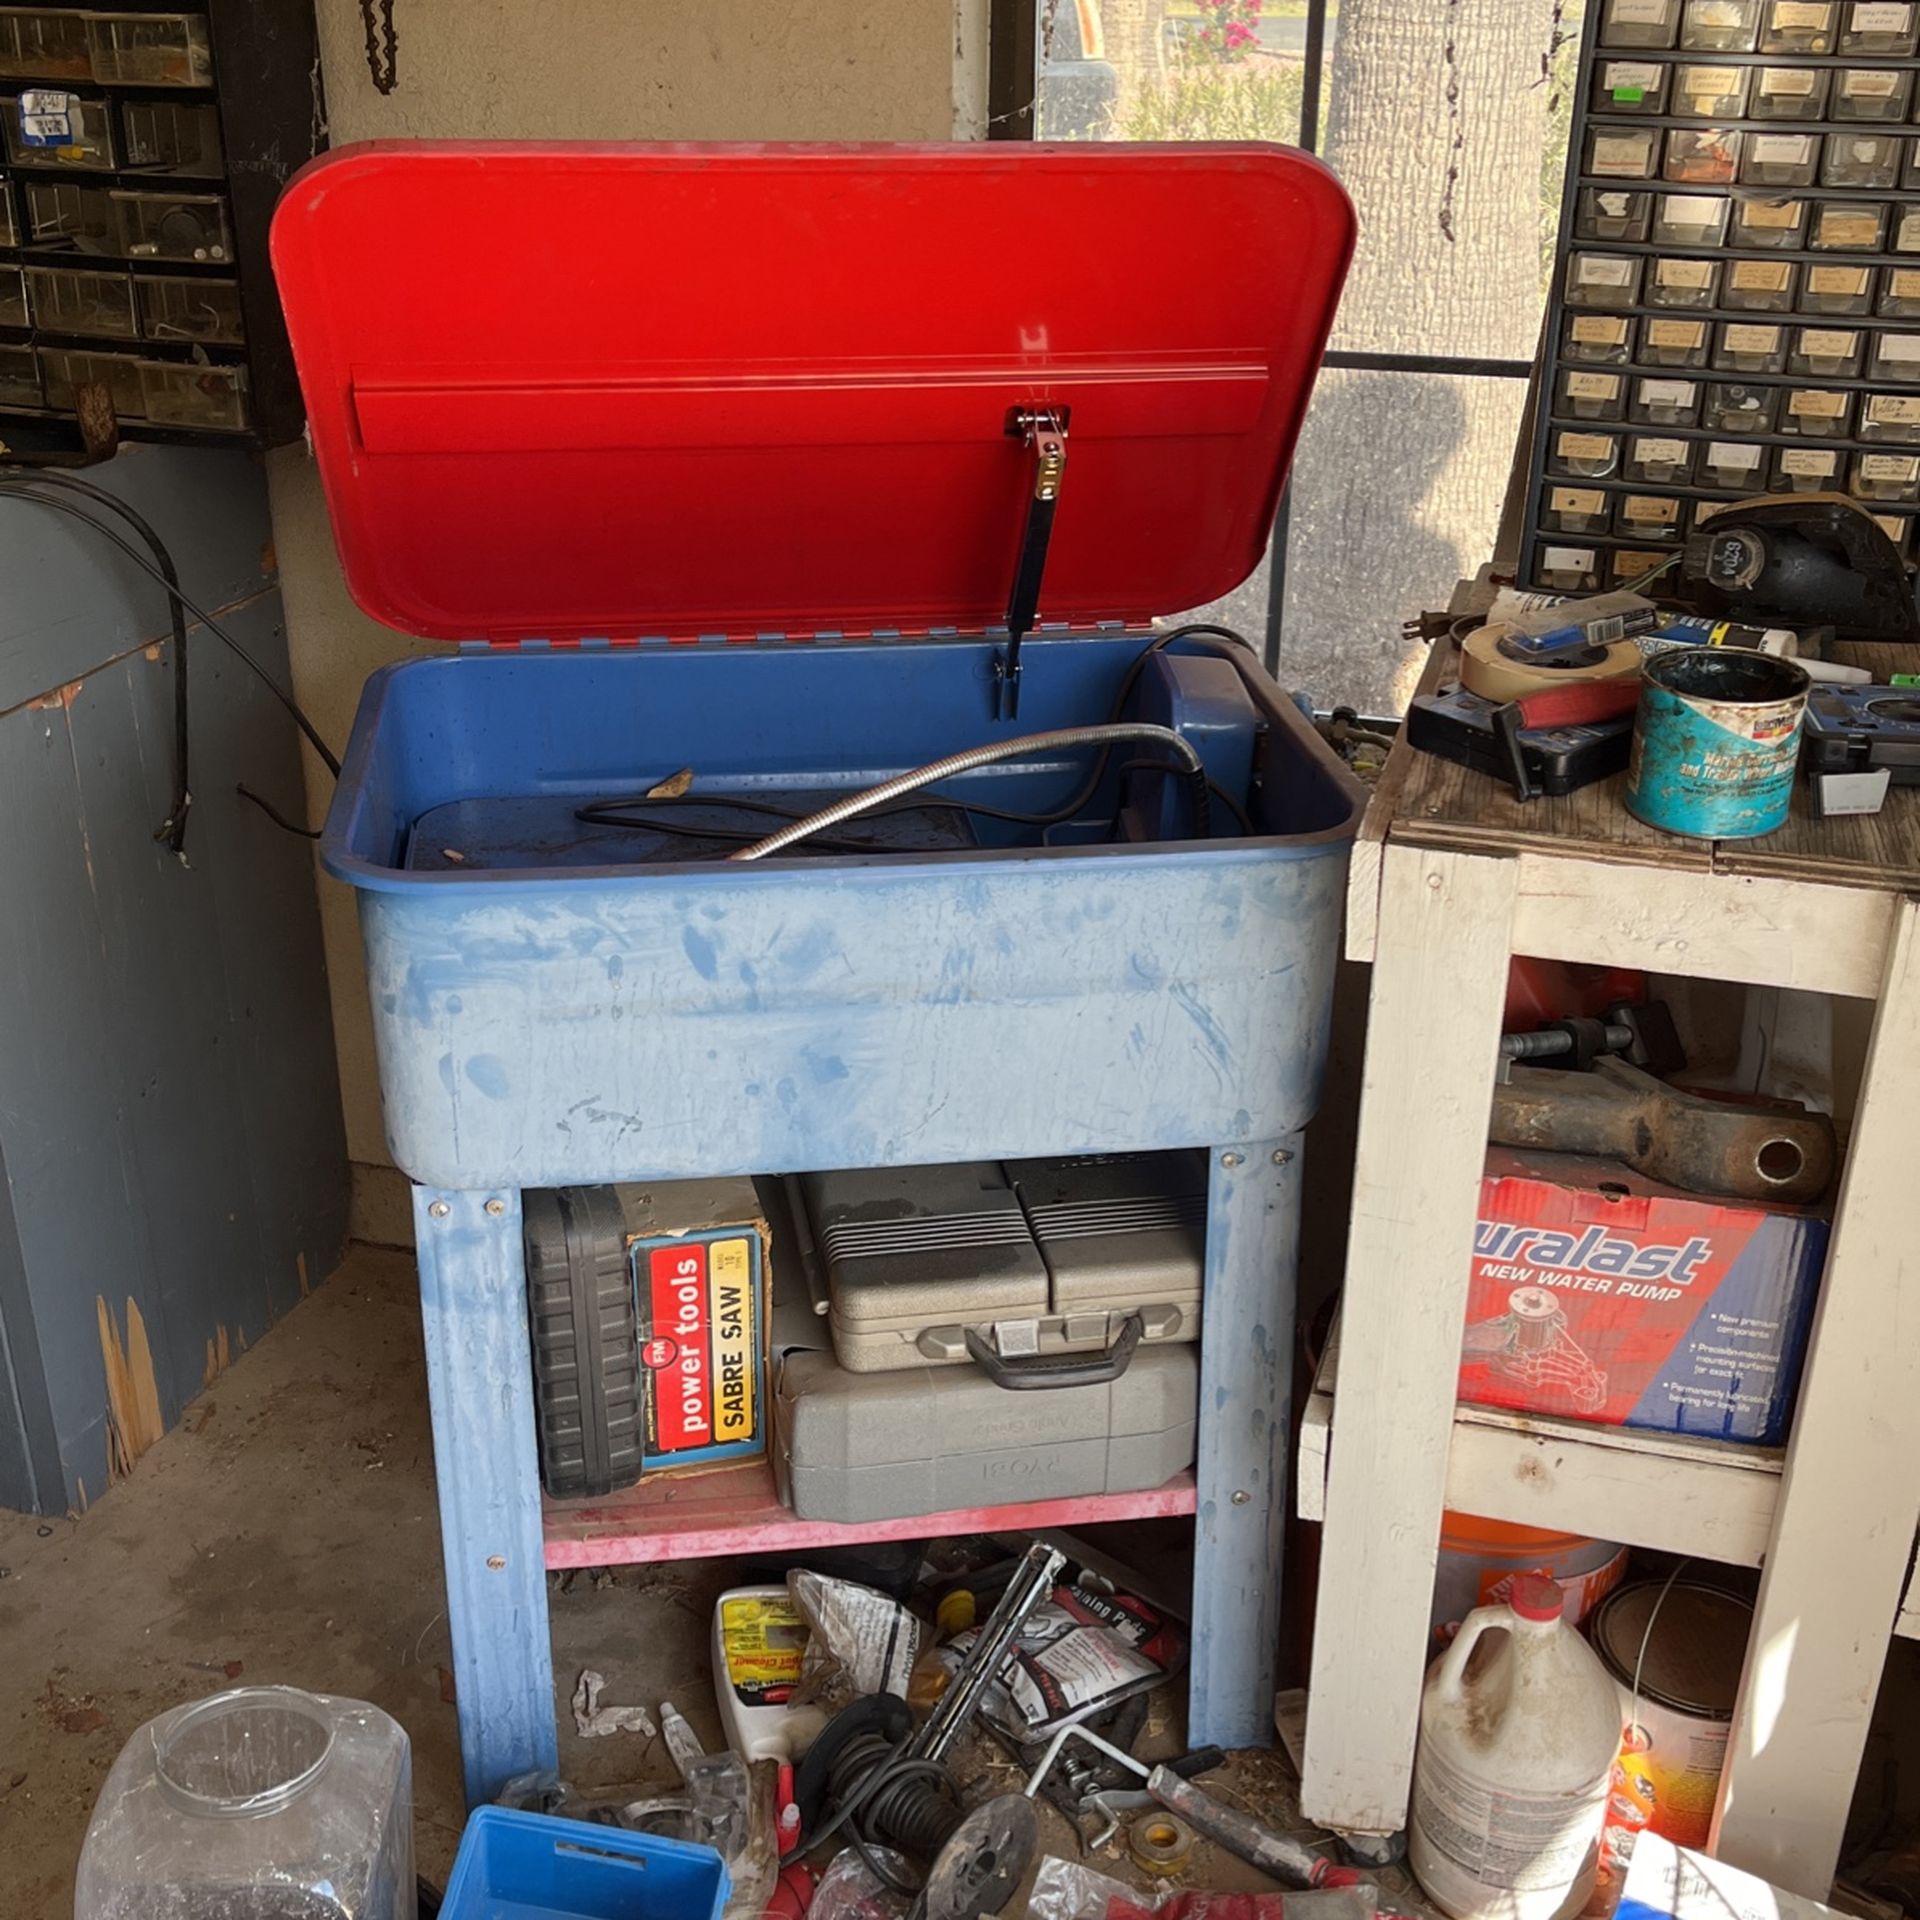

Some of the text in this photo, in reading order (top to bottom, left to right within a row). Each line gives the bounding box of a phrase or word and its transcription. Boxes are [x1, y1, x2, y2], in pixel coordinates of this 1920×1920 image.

[1679, 762, 1700, 777] and
[1474, 1220, 1713, 1284] uralast
[1479, 1262, 1683, 1303] NEW WATER PUMP
[1719, 1313, 1780, 1329] New premium
[1716, 1326, 1770, 1339] components
[652, 1340, 668, 1366] FM
[670, 1258, 710, 1433] power tools
[721, 1287, 745, 1427] SABRE SAW
[1695, 1356, 1777, 1374] mounting surfaces
[1694, 1365, 1707, 1375] for
[1709, 1368, 1733, 1378] exact
[1670, 1382, 1725, 1399] Permanently
[1668, 1393, 1751, 1412] bearing for long life
[1070, 1585, 1113, 1619] raining
[734, 1656, 777, 1667] Cleaner
